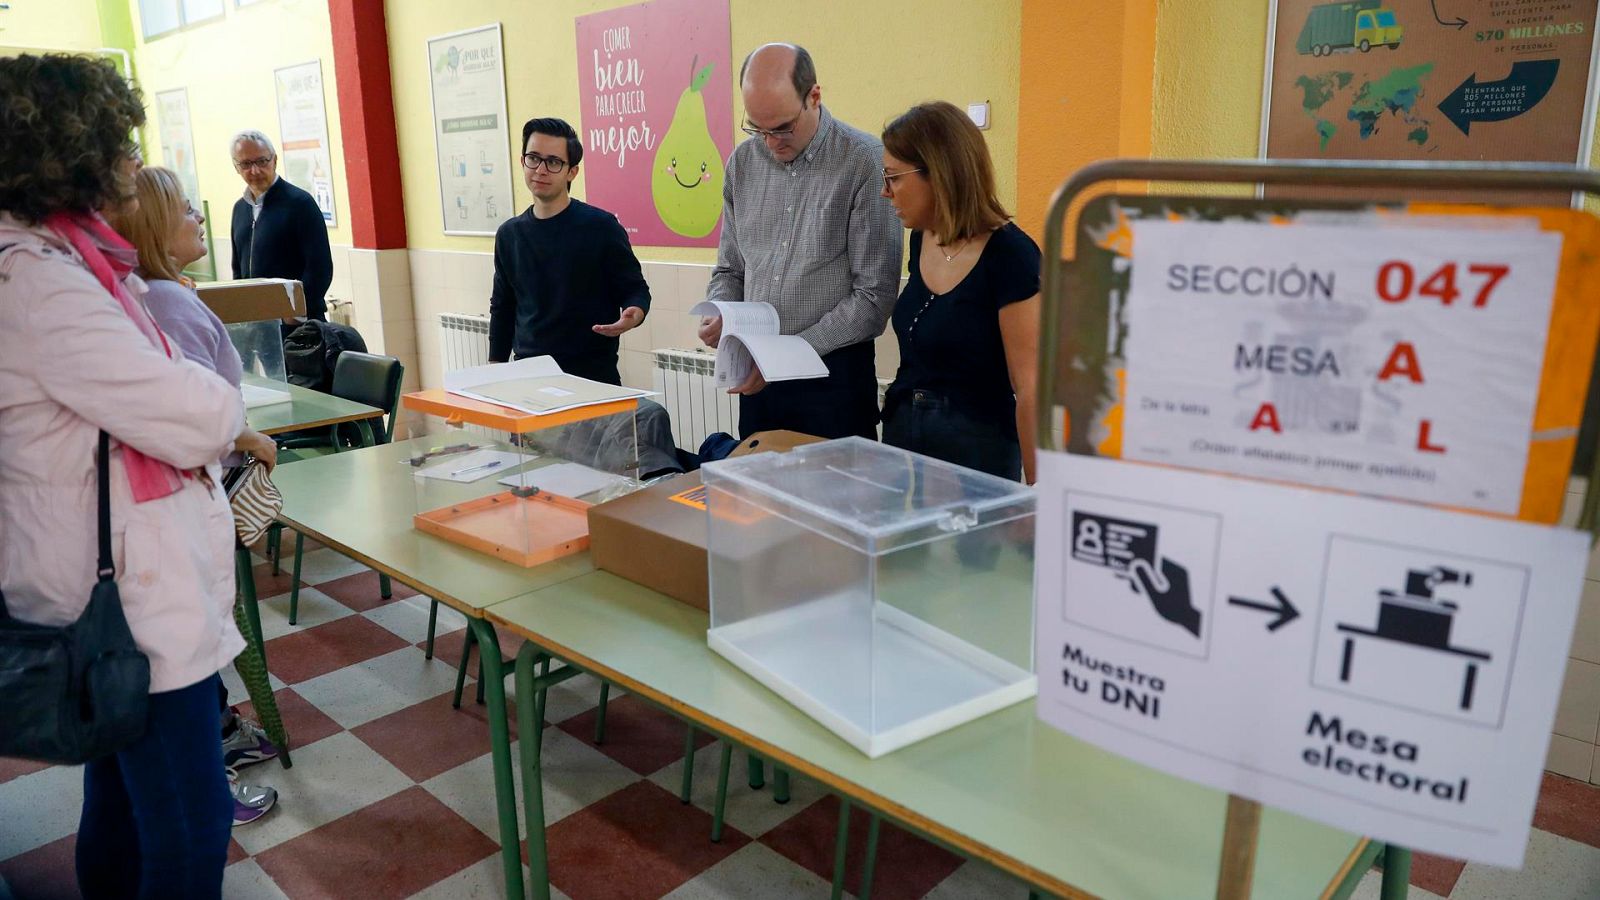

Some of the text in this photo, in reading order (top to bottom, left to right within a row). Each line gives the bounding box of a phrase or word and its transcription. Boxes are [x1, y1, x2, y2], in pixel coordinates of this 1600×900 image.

[603, 25, 631, 52] COMER
[1474, 22, 1585, 41] 870 MILLONES
[1505, 15, 1554, 24] ALIMENTAR
[593, 49, 644, 91] bien
[1464, 86, 1505, 94] MIENTRAS
[595, 90, 646, 117] PARA CRECER
[1481, 98, 1522, 107] PERSONAS
[1484, 92, 1526, 100] MILLONES
[590, 117, 656, 168] mejor
[1166, 260, 1512, 309] SECCIÓN 047
[1233, 342, 1425, 384] MESA A
[1248, 401, 1283, 434] A
[1416, 419, 1448, 455] L
[1062, 643, 1166, 693] Muestra
[1062, 667, 1161, 720] tu DNI
[1305, 711, 1420, 763] Mesa
[1301, 744, 1469, 804] electoral
